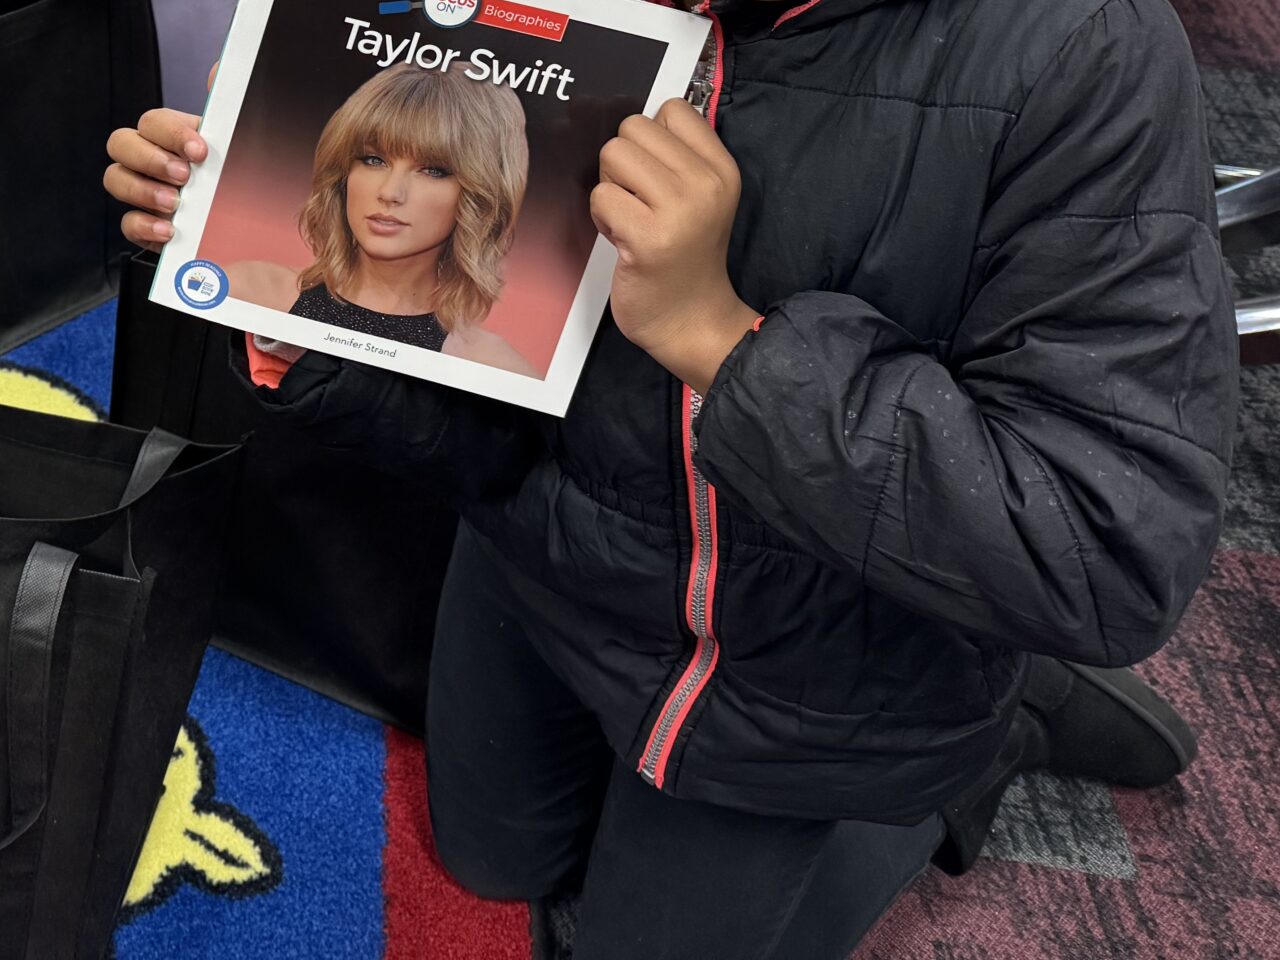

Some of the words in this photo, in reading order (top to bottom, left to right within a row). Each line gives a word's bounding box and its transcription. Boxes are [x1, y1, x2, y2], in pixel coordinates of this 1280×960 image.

[484, 4, 562, 32] Biographies
[344, 16, 460, 72] Taylor
[464, 48, 574, 101] Swift
[323, 332, 363, 349] Jennifer
[364, 342, 397, 358] Strand
